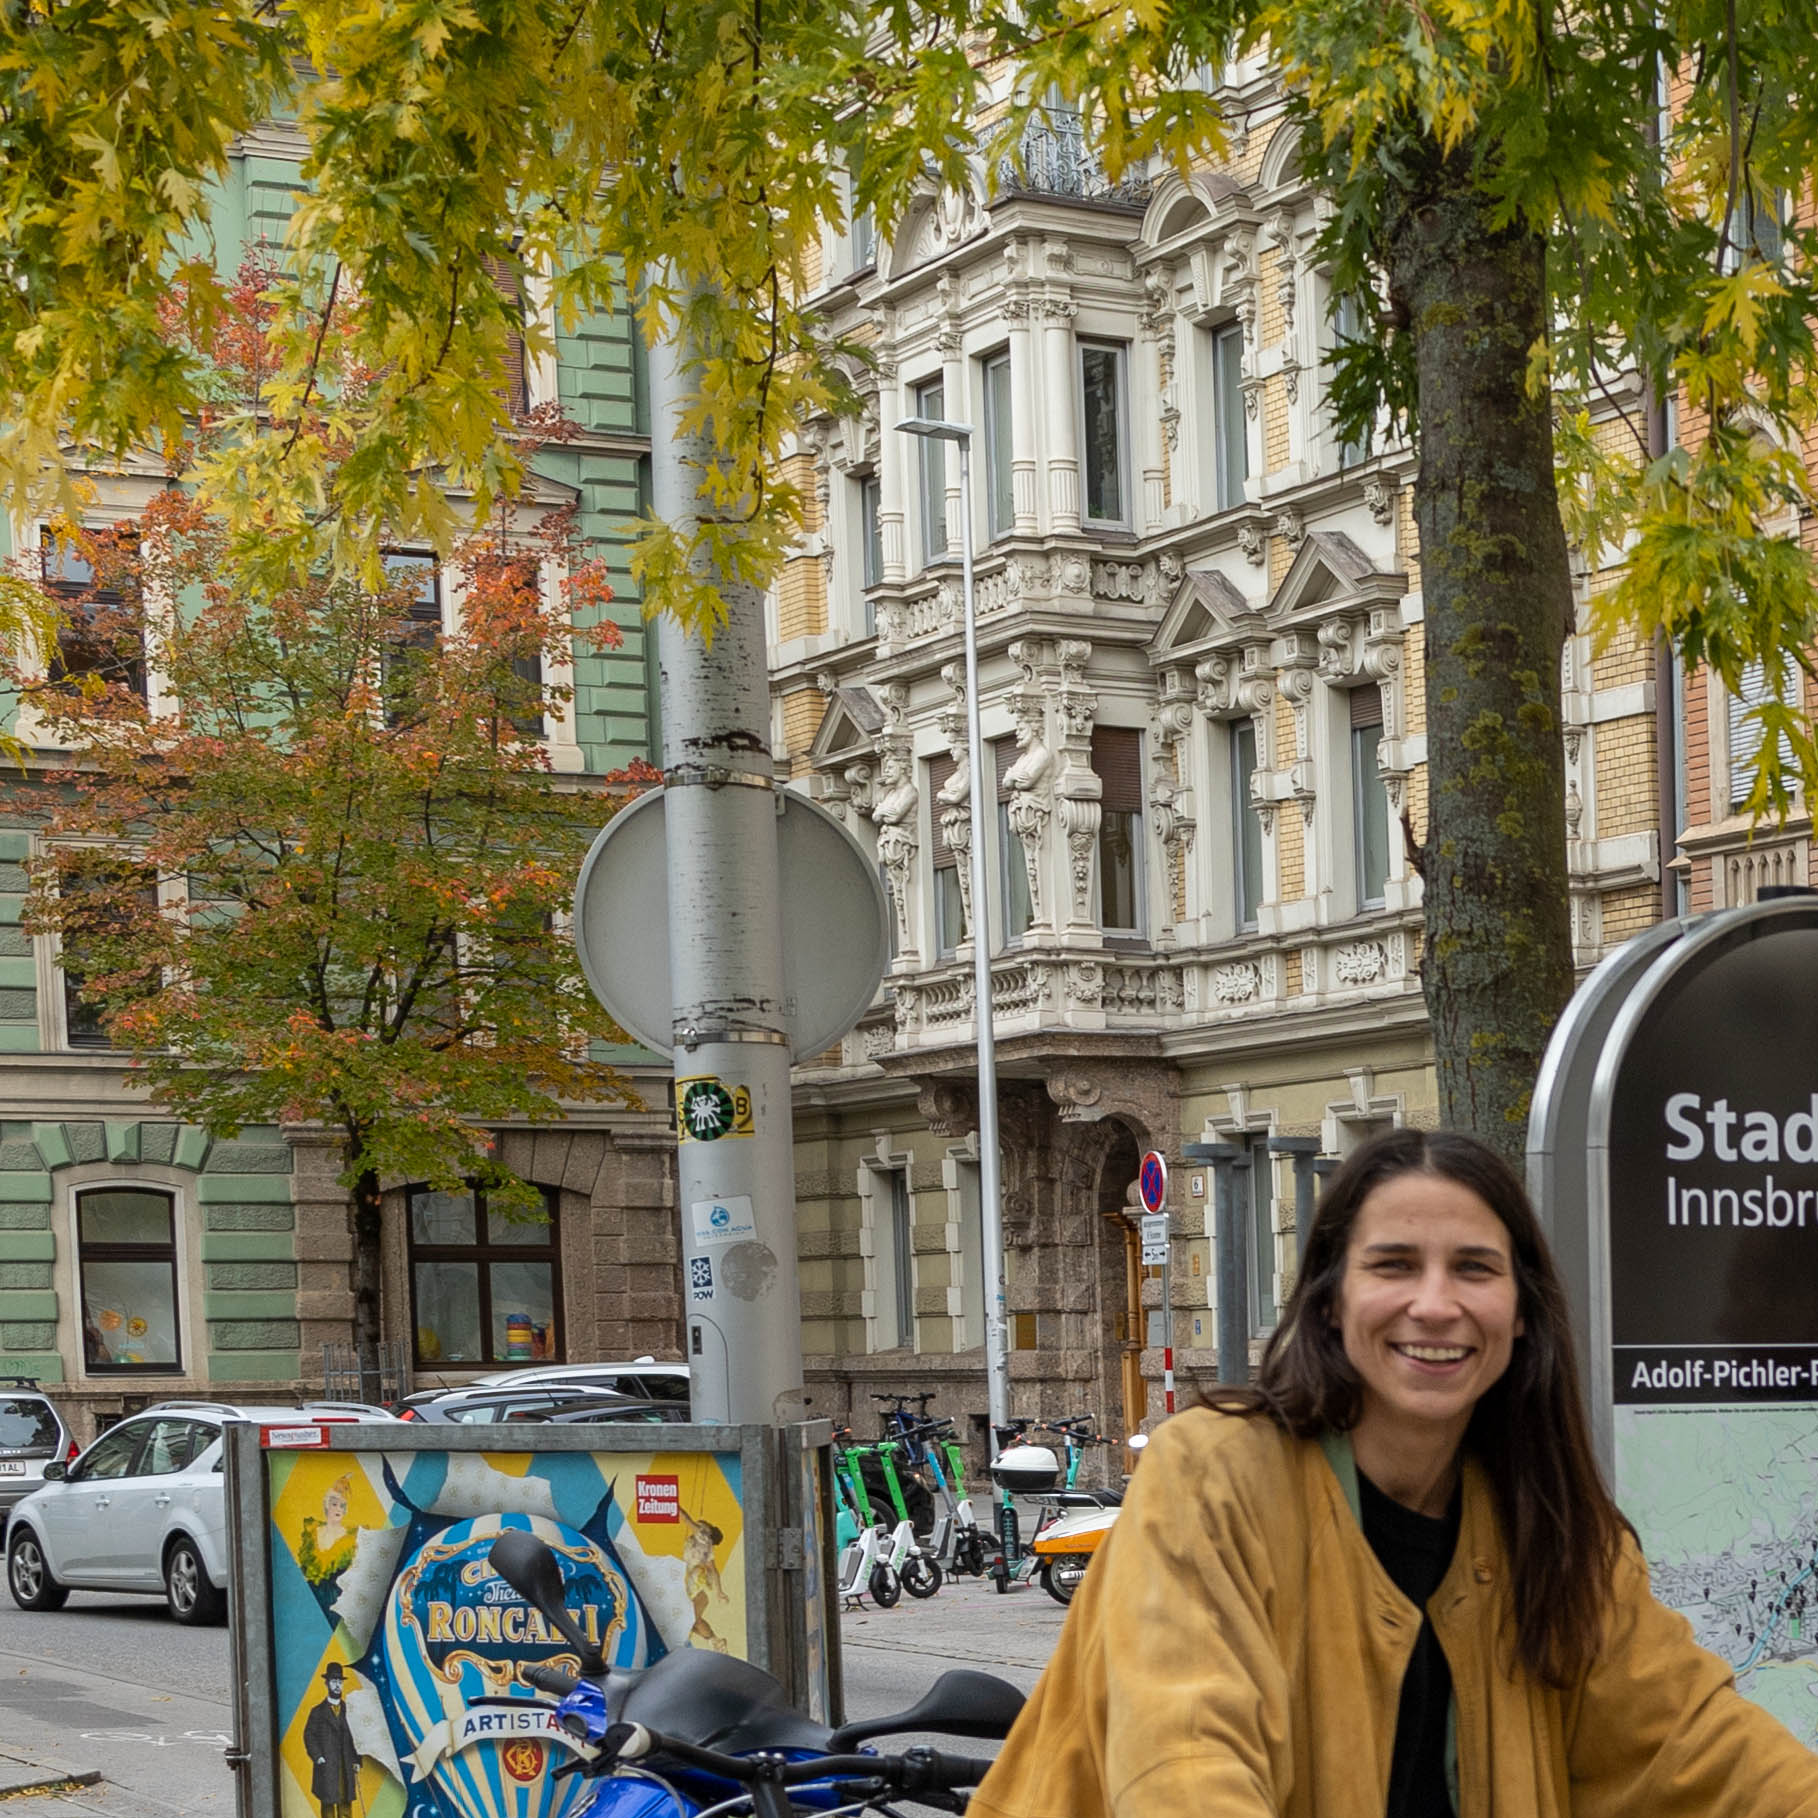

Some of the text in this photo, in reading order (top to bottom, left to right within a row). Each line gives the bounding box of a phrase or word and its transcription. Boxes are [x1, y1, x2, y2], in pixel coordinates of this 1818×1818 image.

[693, 1289, 714, 1300] POW
[637, 1480, 678, 1497] Kronen
[637, 1498, 678, 1517] Zeitung
